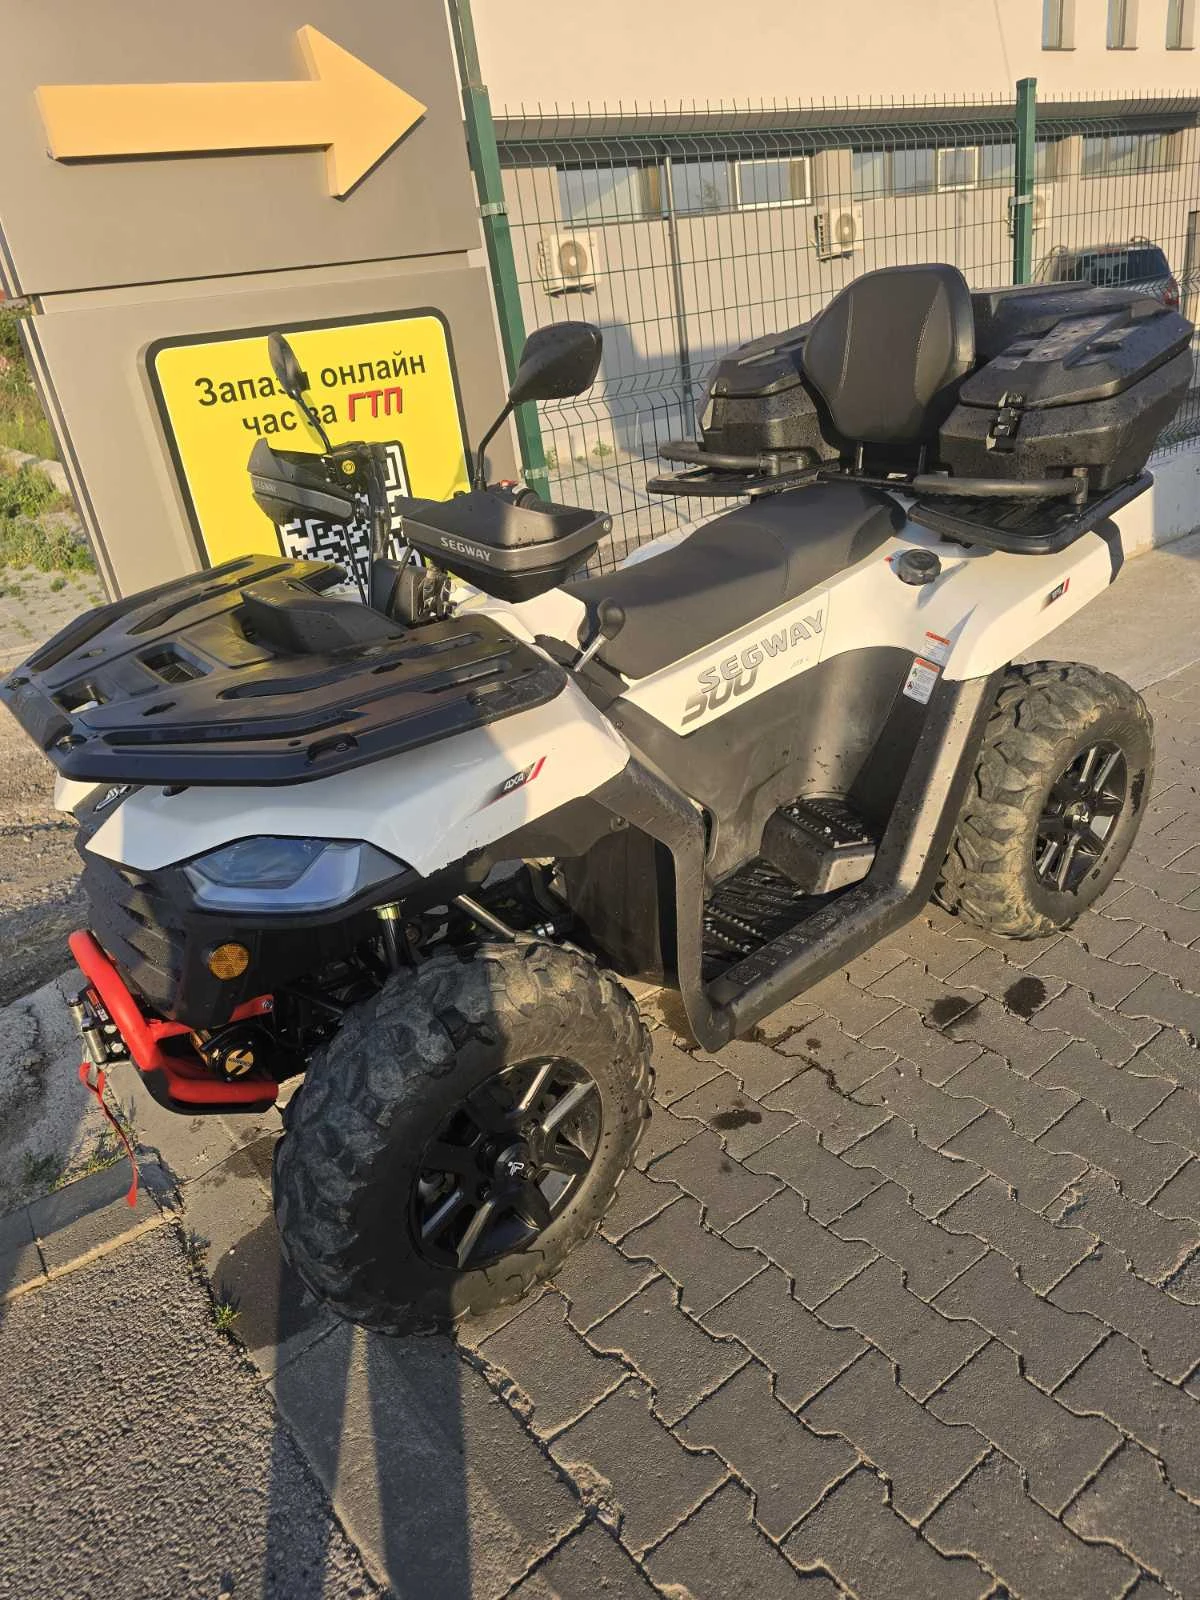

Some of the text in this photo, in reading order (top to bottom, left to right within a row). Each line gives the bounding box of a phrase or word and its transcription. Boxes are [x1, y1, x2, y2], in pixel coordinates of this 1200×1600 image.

[194, 350, 426, 406] Запа онлайн
[242, 410, 297, 436] час
[348, 386, 403, 422] ГТП
[440, 537, 490, 562] SEGWAY
[697, 608, 824, 694] SEGWAY
